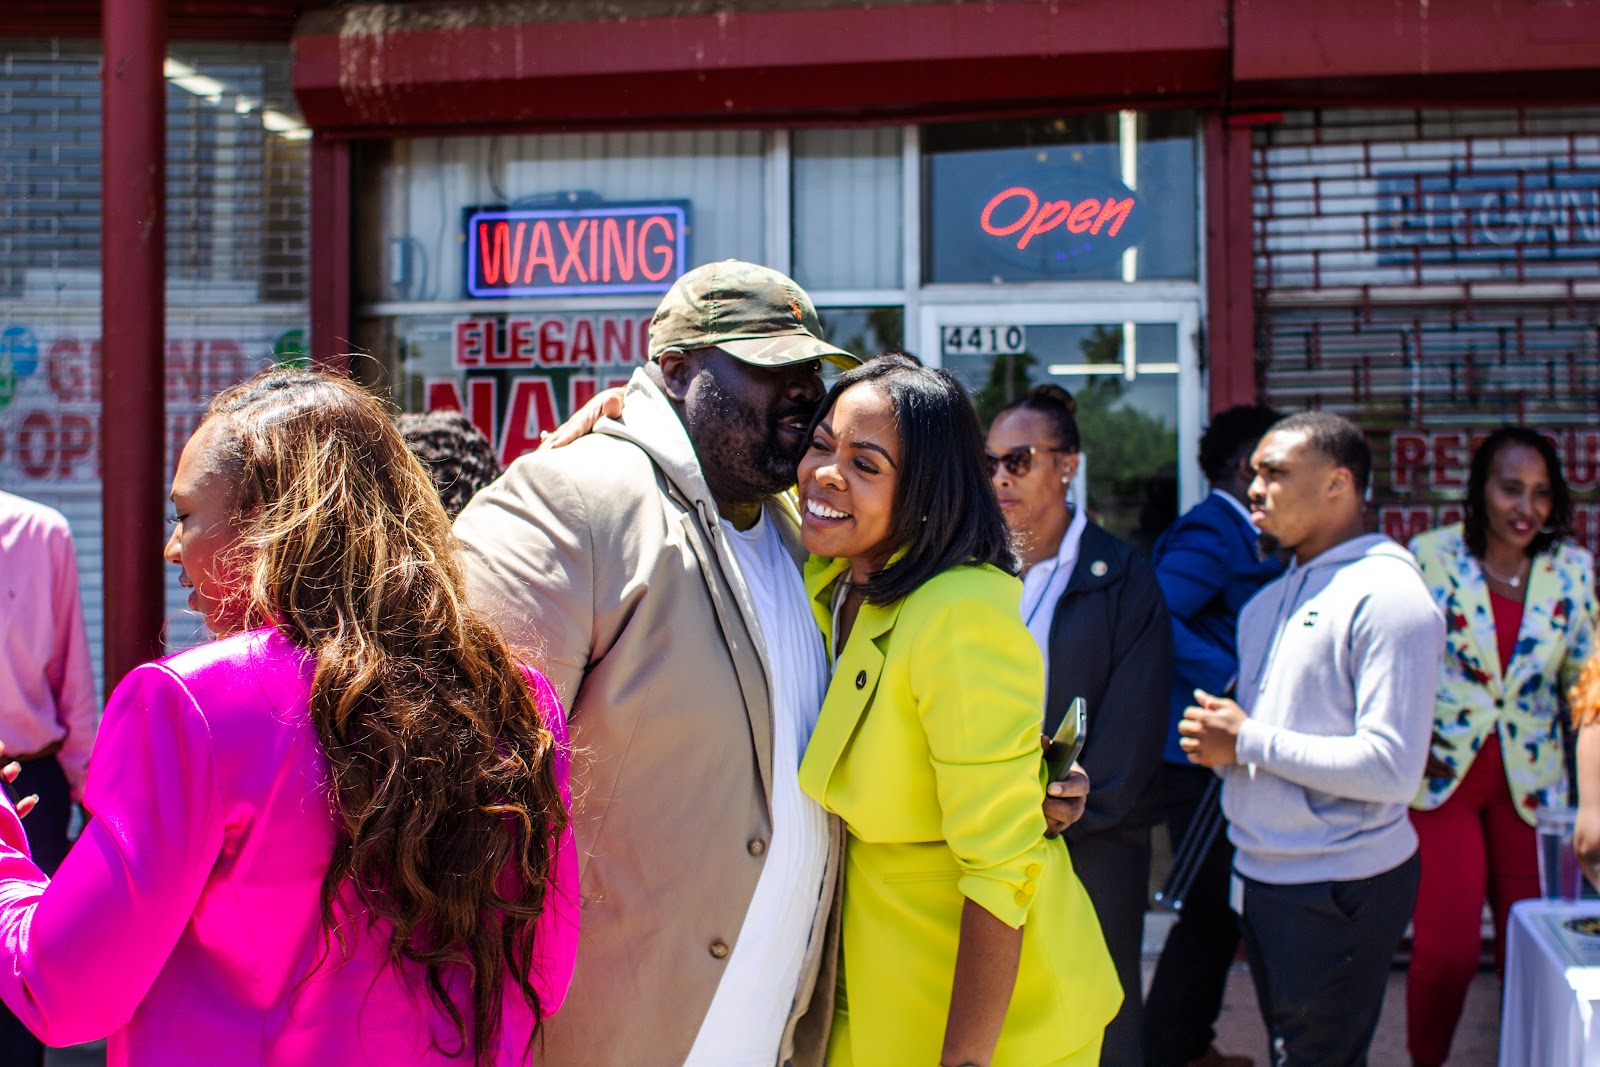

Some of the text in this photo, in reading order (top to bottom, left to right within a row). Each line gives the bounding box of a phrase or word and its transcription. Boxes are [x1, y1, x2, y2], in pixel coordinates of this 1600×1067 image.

[479, 215, 675, 284] WAXING
[980, 186, 1135, 250] Open
[947, 326, 1022, 351] 4410
